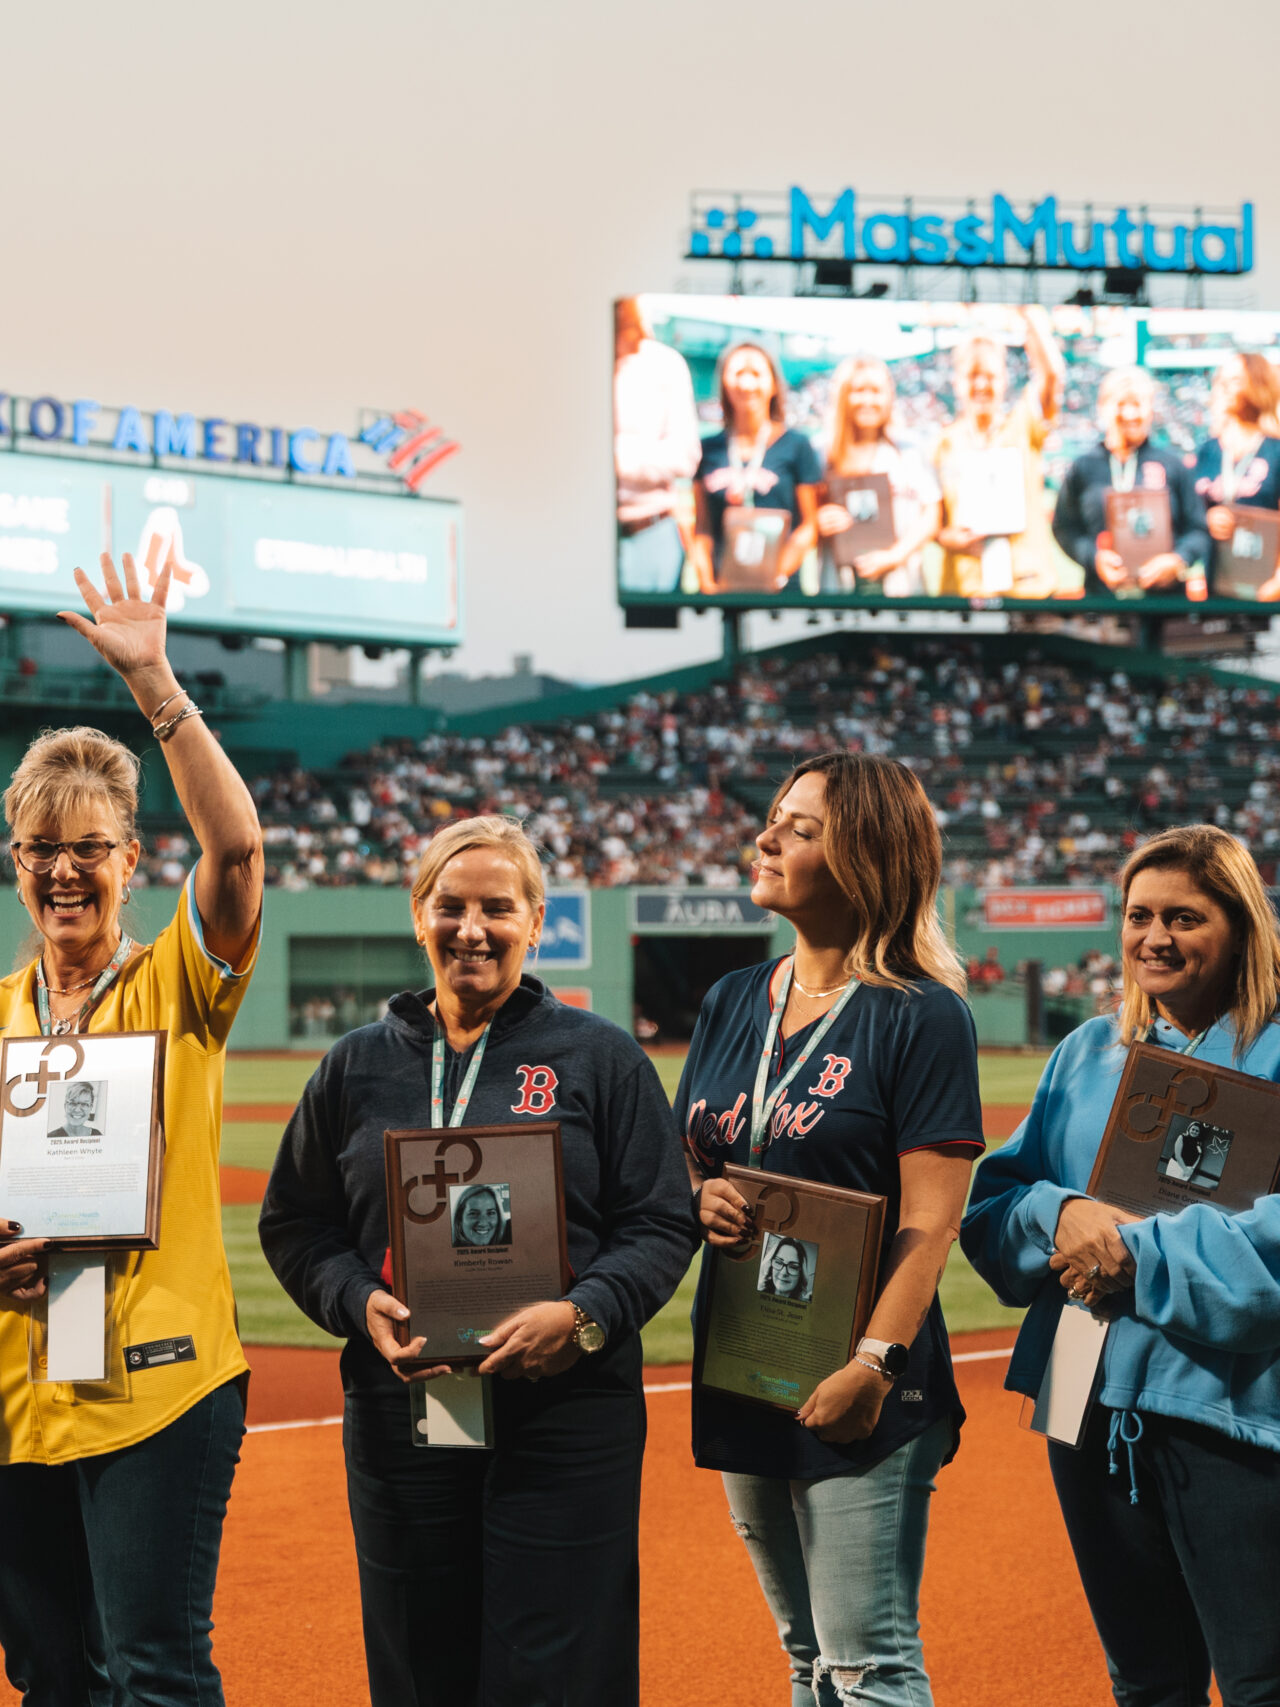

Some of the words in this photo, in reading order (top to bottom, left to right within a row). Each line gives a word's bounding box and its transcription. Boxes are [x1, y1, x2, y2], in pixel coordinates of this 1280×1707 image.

[790, 186, 1253, 272] MassMutual
[29, 397, 100, 446] OF
[113, 405, 357, 478] AMERICA
[510, 1064, 558, 1115] B
[808, 1053, 852, 1097] B
[47, 1148, 78, 1156] Kathleen
[80, 1147, 103, 1155] Whyte
[454, 1260, 486, 1268] Kimberly
